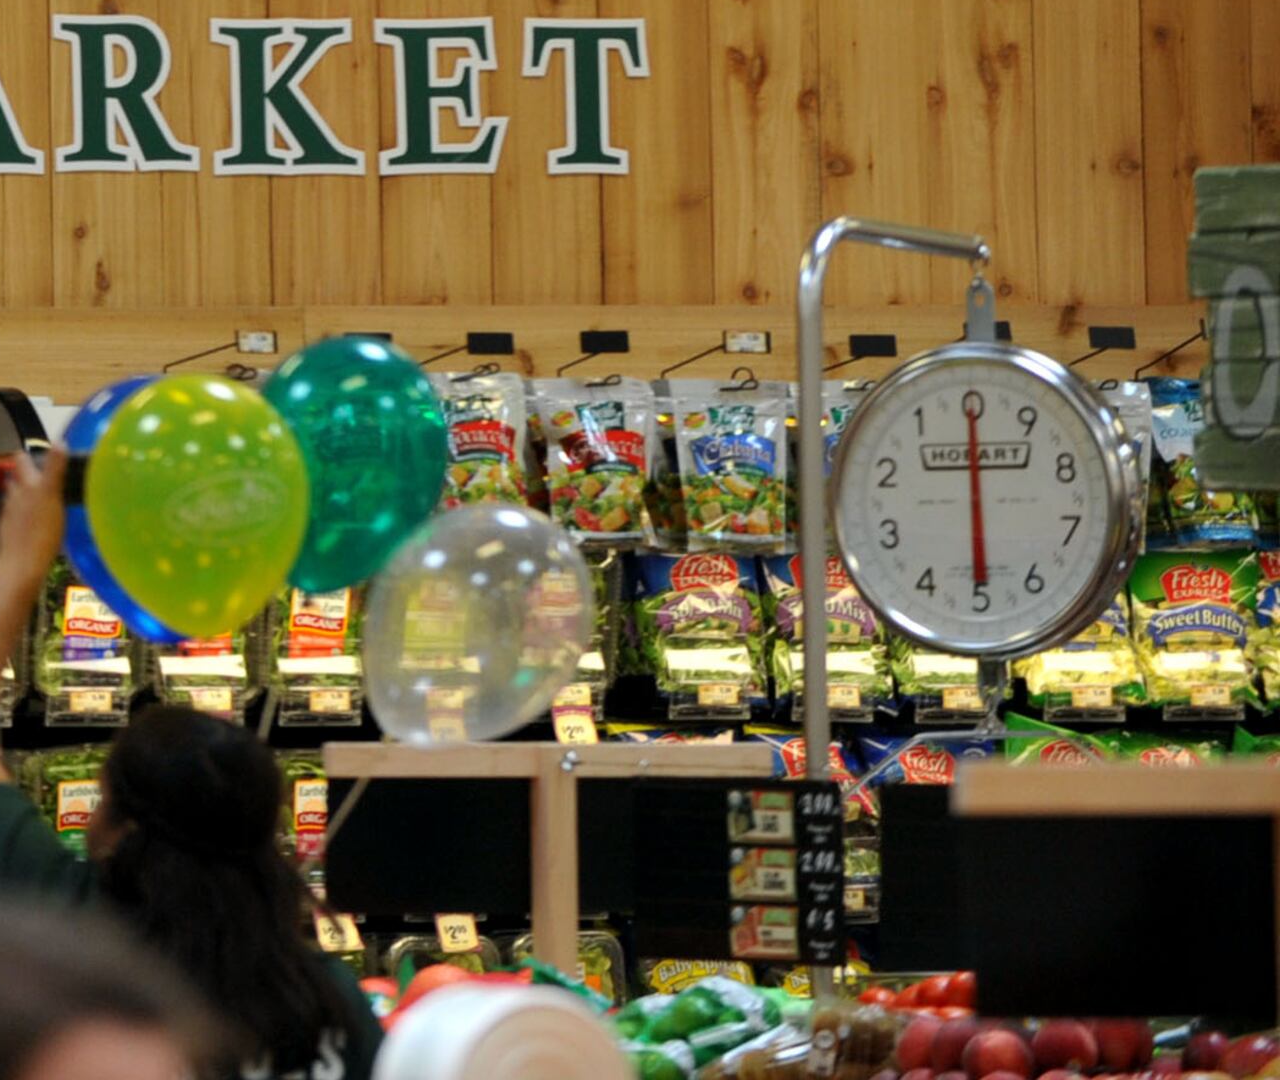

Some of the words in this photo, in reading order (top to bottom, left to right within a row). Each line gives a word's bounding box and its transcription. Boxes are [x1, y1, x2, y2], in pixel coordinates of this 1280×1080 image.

[913, 407, 924, 436] 1
[1017, 406, 1038, 436] 9
[876, 458, 897, 488] 2
[1055, 453, 1076, 483] 8
[879, 519, 899, 549] 3
[1060, 515, 1081, 546] 7
[915, 567, 936, 597] 4
[1023, 563, 1044, 593] 6
[1171, 569, 1224, 588] Fresh
[971, 582, 991, 613] 5
[1156, 609, 1198, 634] Sweet
[906, 751, 948, 772] Fresh
